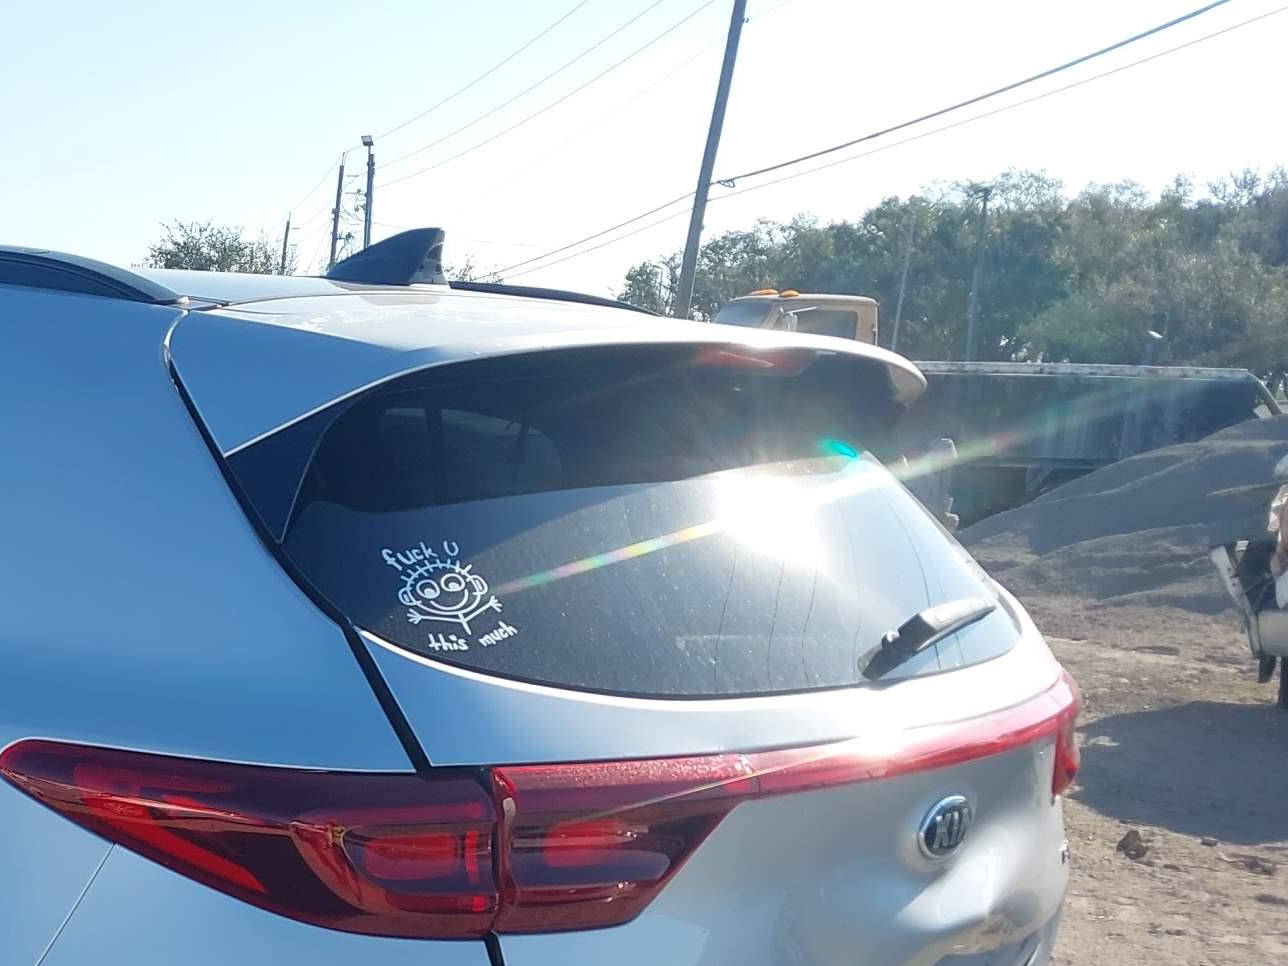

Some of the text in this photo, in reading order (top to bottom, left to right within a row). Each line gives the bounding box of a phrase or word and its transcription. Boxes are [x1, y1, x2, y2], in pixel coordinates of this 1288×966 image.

[428, 620, 519, 651] this much
[932, 807, 973, 850] KIA
